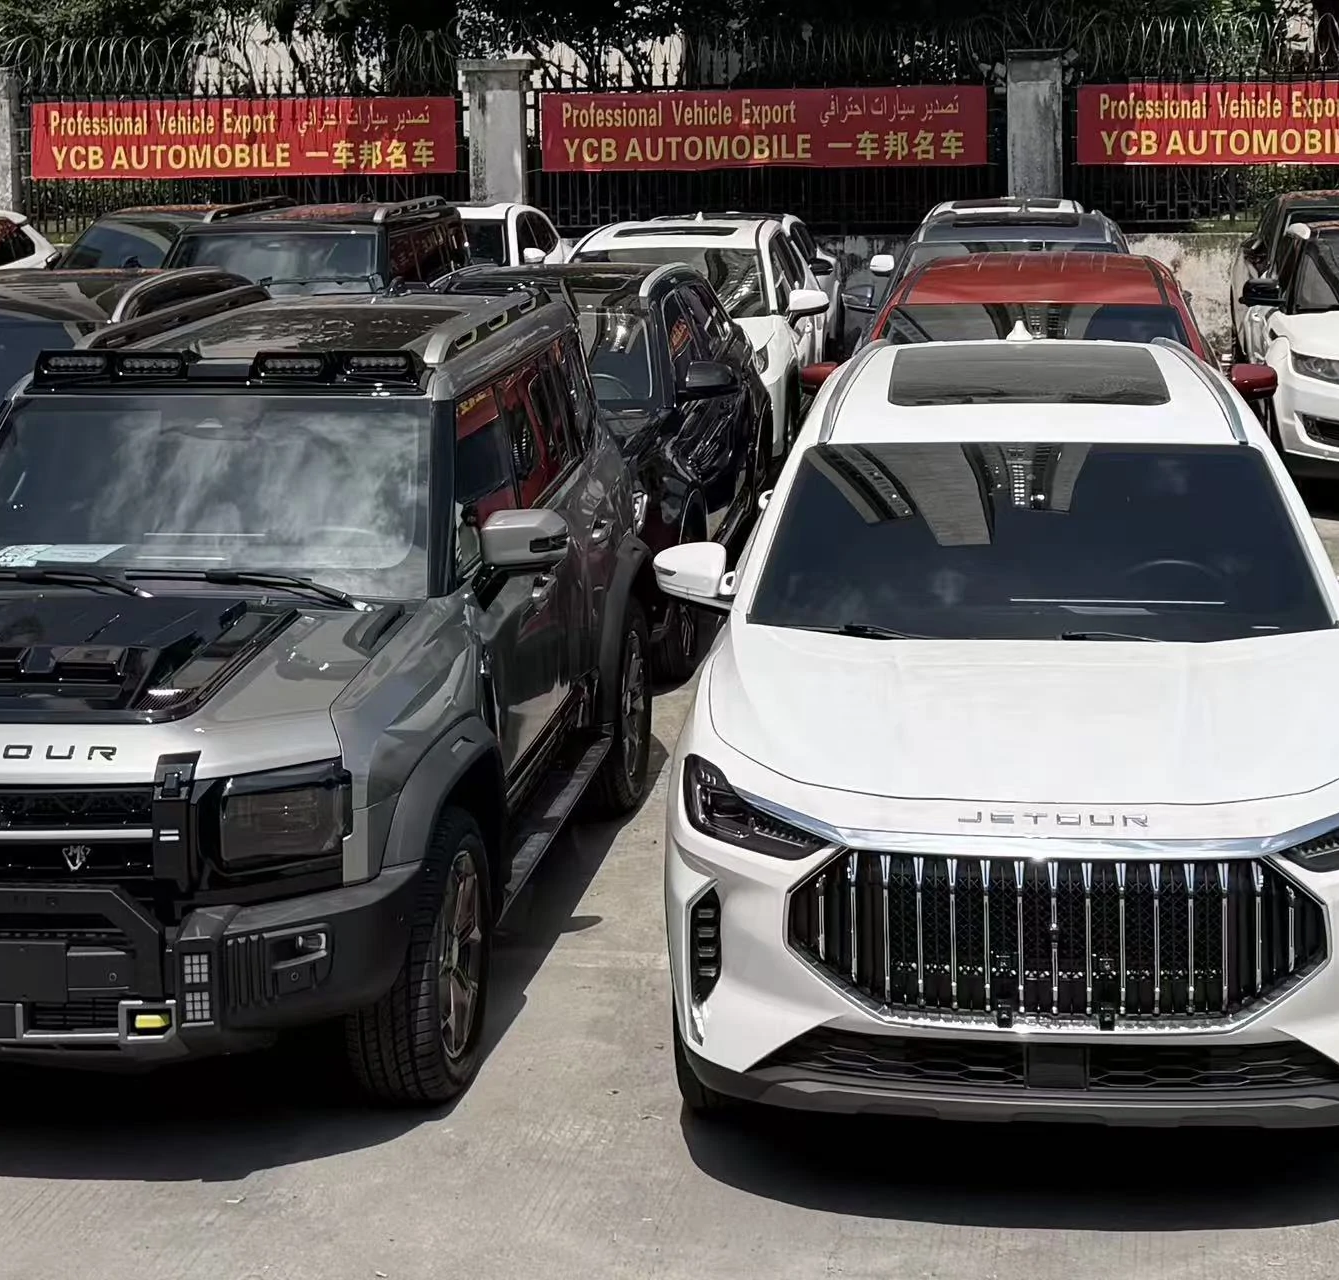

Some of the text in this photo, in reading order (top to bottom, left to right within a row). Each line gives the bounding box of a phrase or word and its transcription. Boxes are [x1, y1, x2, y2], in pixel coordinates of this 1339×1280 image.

[561, 98, 796, 130] Professional Vehicle Export
[1099, 93, 1207, 120] Professional
[1217, 92, 1282, 118] Vehicle
[49, 108, 276, 139] Professional Vehicle Export
[305, 138, 435, 169] 一车邦名车
[563, 134, 812, 162] YCB AUTOMOBILE
[827, 129, 965, 160] 一车邦名车
[1100, 130, 1159, 156] YCB
[51, 144, 291, 172] YCB AUTOMOBILE
[957, 810, 1149, 828] JETOUR
